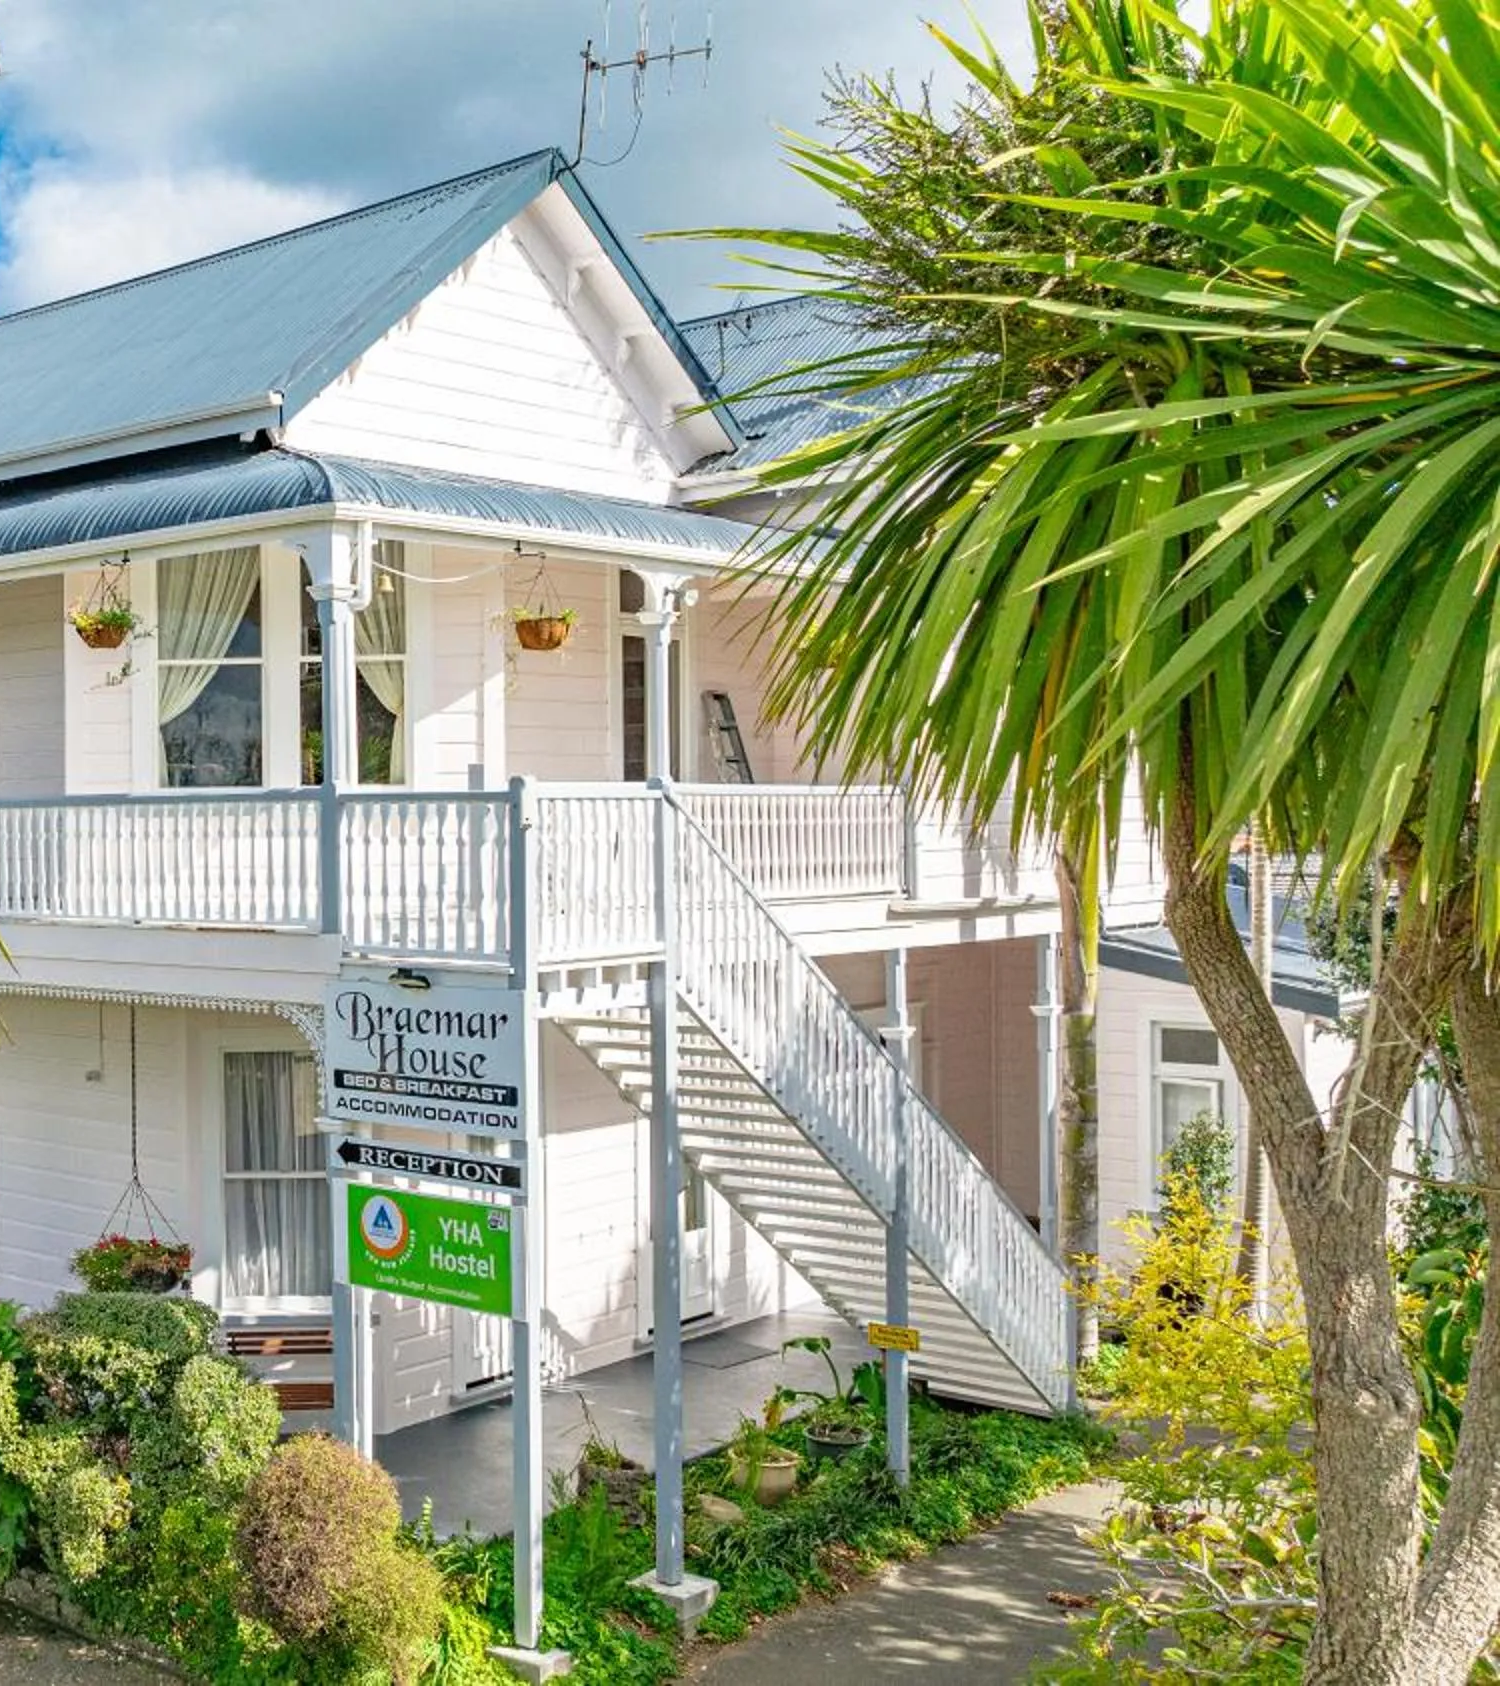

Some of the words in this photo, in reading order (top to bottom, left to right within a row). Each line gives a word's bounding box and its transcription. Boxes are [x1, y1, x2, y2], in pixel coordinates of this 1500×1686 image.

[336, 991, 508, 1040] Braemar
[368, 1033, 488, 1079] House
[343, 1073, 377, 1089] BED
[379, 1076, 392, 1091] &
[395, 1078, 507, 1103] BREAKFAST
[336, 1096, 518, 1129] ACCOMMODATION
[358, 1146, 504, 1185] RECEPTION
[438, 1215, 484, 1248] YHA
[429, 1244, 496, 1280] Hostel
